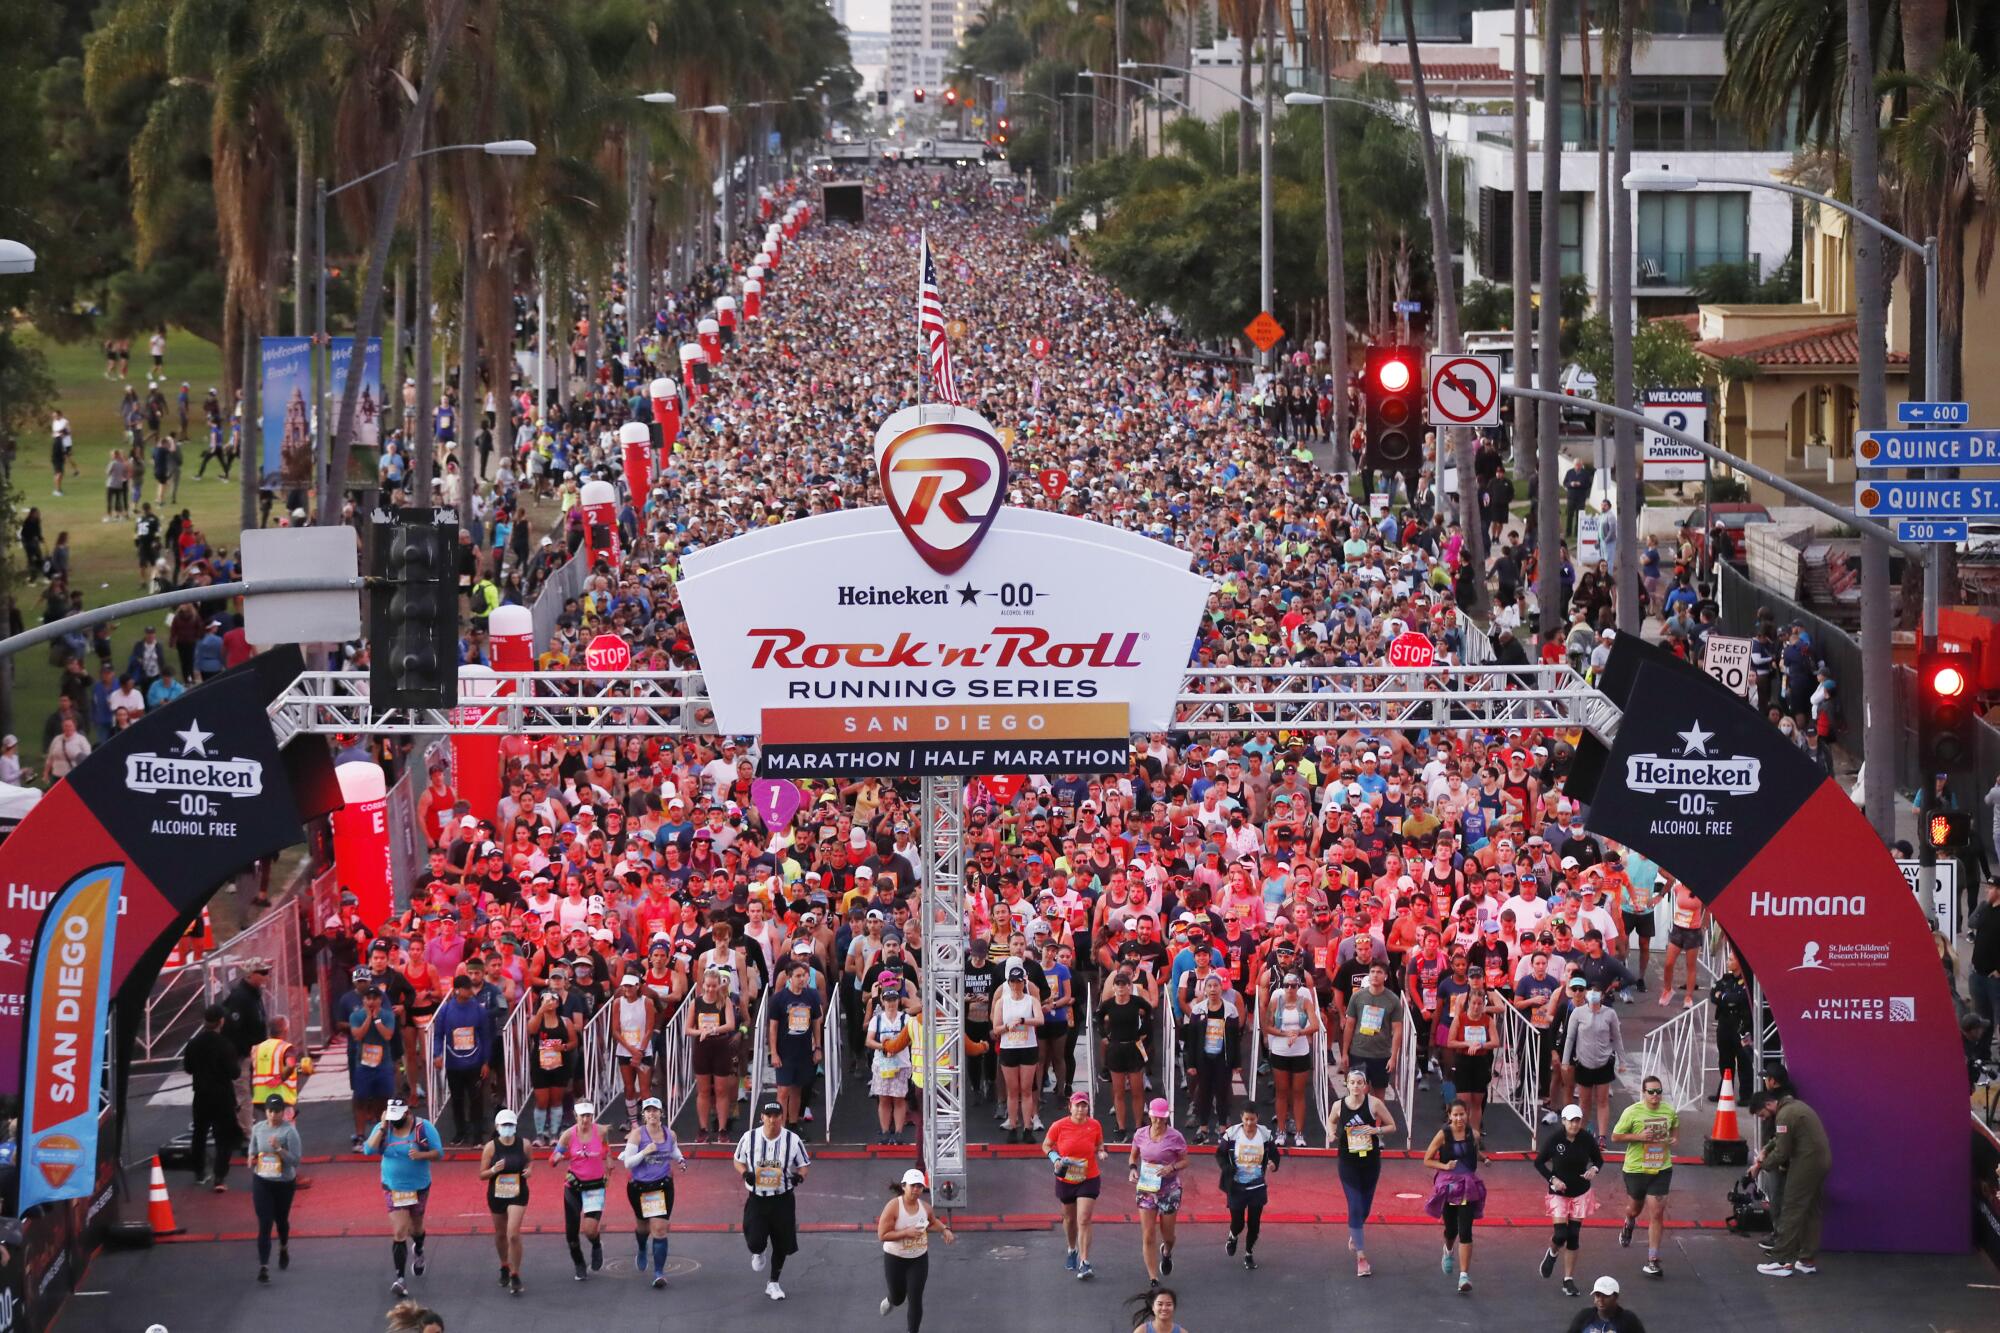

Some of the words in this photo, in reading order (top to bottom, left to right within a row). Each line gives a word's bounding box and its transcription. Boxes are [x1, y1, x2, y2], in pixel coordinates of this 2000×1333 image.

[1036, 340, 1044, 350] 8
[1648, 391, 1703, 402] WELCOME
[665, 401, 673, 411] 4
[1933, 406, 1959, 420] 600
[643, 446, 651, 459] 3
[1649, 447, 1700, 458] PARKING
[1048, 473, 1059, 487] 5
[588, 511, 598, 524] 2
[1909, 525, 1934, 538] 500
[838, 586, 949, 605] Heineken
[1001, 583, 1033, 607] 0.0
[747, 628, 932, 669] Rock
[991, 627, 1142, 668] Roll
[1393, 644, 1431, 664] STOP
[1711, 643, 1747, 654] SPEED
[590, 648, 626, 667] STOP
[1712, 654, 1742, 665] LIMIT
[1710, 666, 1743, 687] 30
[789, 680, 957, 699] RUNNING
[968, 680, 1098, 698] SERIES
[844, 716, 908, 732] SAN
[935, 715, 1045, 731] DIEGO
[767, 751, 900, 769] MARATHON
[925, 751, 985, 768] HALF
[993, 750, 1126, 766] MARATHON
[135, 761, 253, 788] Heineken
[1635, 761, 1751, 786] Heineken
[770, 785, 781, 809] 1
[151, 820, 205, 836] ALCOHOL
[209, 822, 237, 837] FREE
[373, 812, 384, 834] E
[1650, 820, 1700, 835] ALCOHOL
[1705, 821, 1732, 835] FREE
[1750, 891, 1865, 916] Humana
[1838, 944, 1854, 952] Jude
[1855, 943, 1889, 951] Children's
[1860, 952, 1889, 960] Hospital
[55, 915, 89, 1022] DIEGO
[1819, 999, 1884, 1008] UNITED
[1801, 1010, 1884, 1020] AIRLINES
[50, 1032, 79, 1103] SAN
